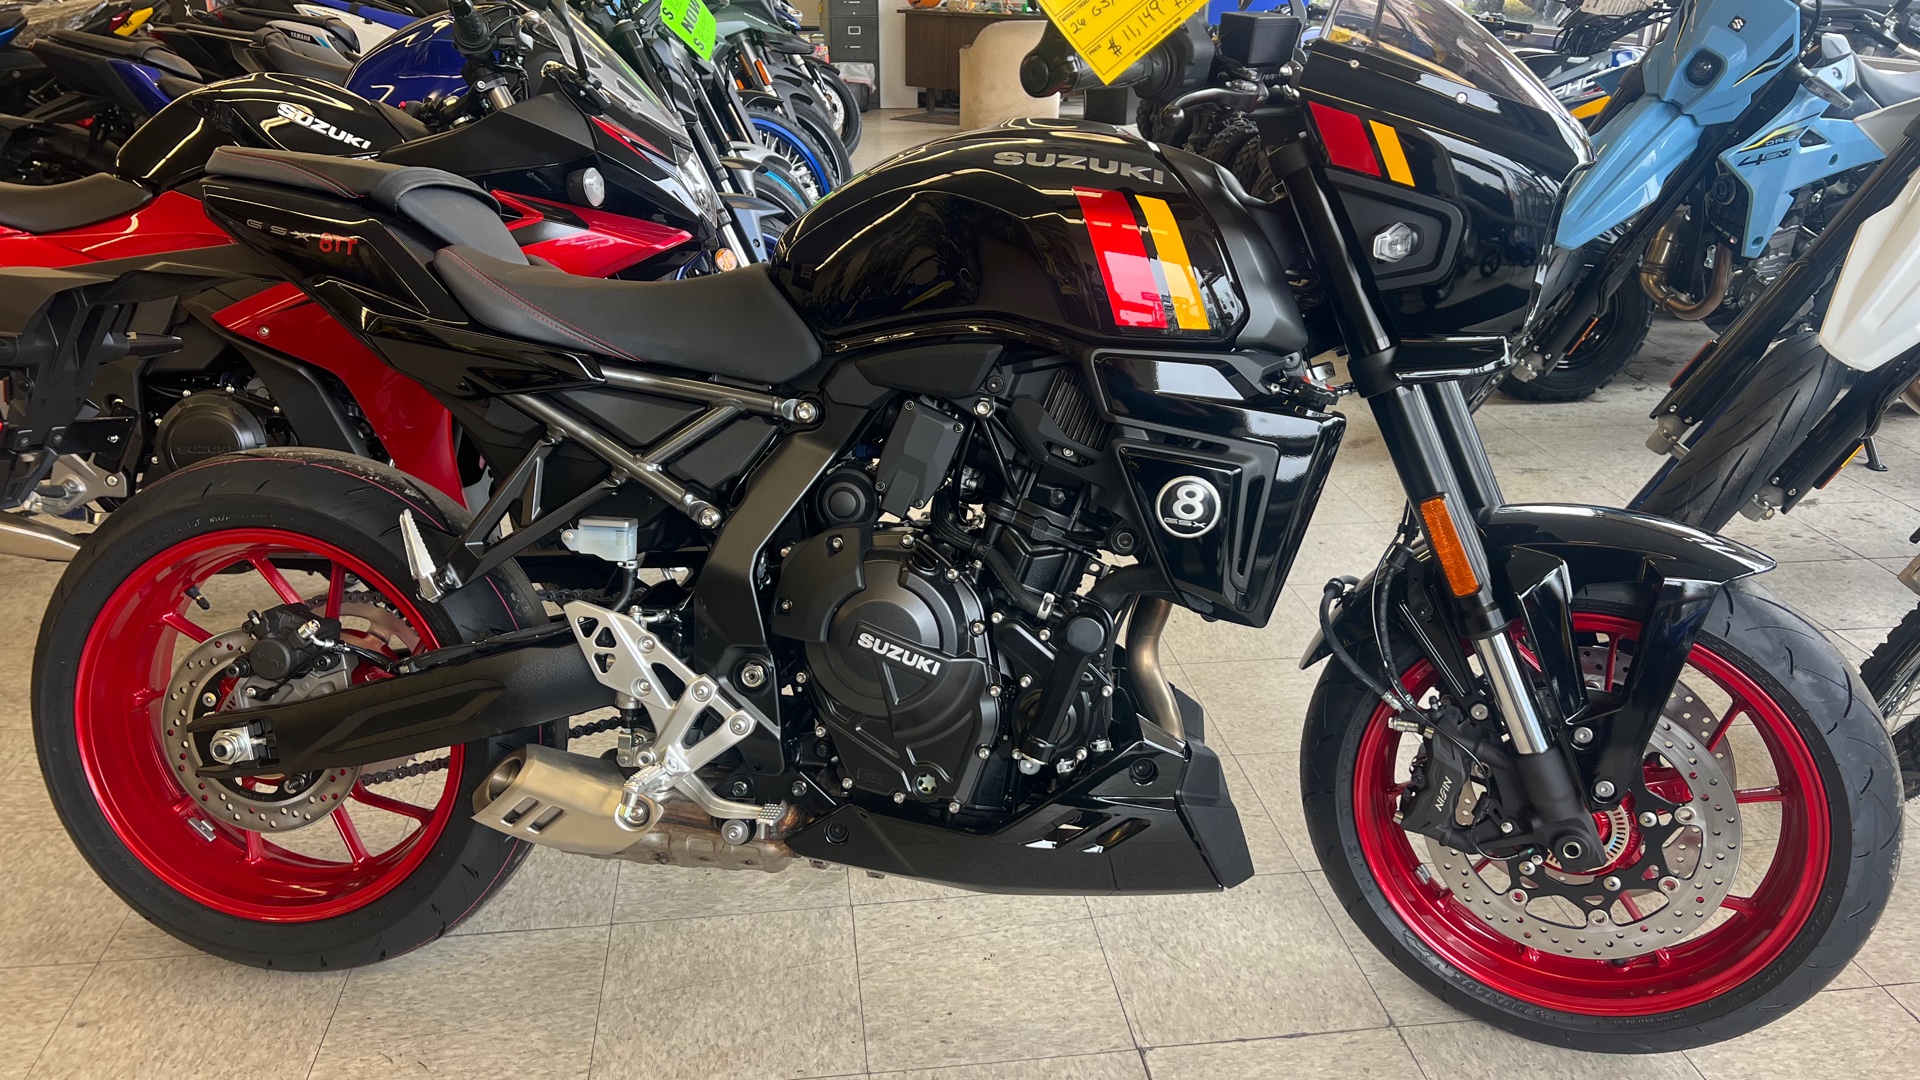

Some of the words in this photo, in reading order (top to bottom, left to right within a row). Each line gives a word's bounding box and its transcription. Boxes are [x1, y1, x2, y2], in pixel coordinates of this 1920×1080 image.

[681, 0, 700, 34] NOW
[290, 30, 311, 42] YAMAHA
[277, 103, 371, 149] SUZUKI
[1765, 134, 1797, 147] DR-Z
[993, 151, 1164, 185] SUZUKI
[1172, 484, 1205, 520] 8
[1163, 517, 1206, 528] GSX
[857, 632, 941, 676] SUZUKI
[1434, 775, 1453, 812] NISSIN
[1451, 972, 1529, 1014] DUNLOP
